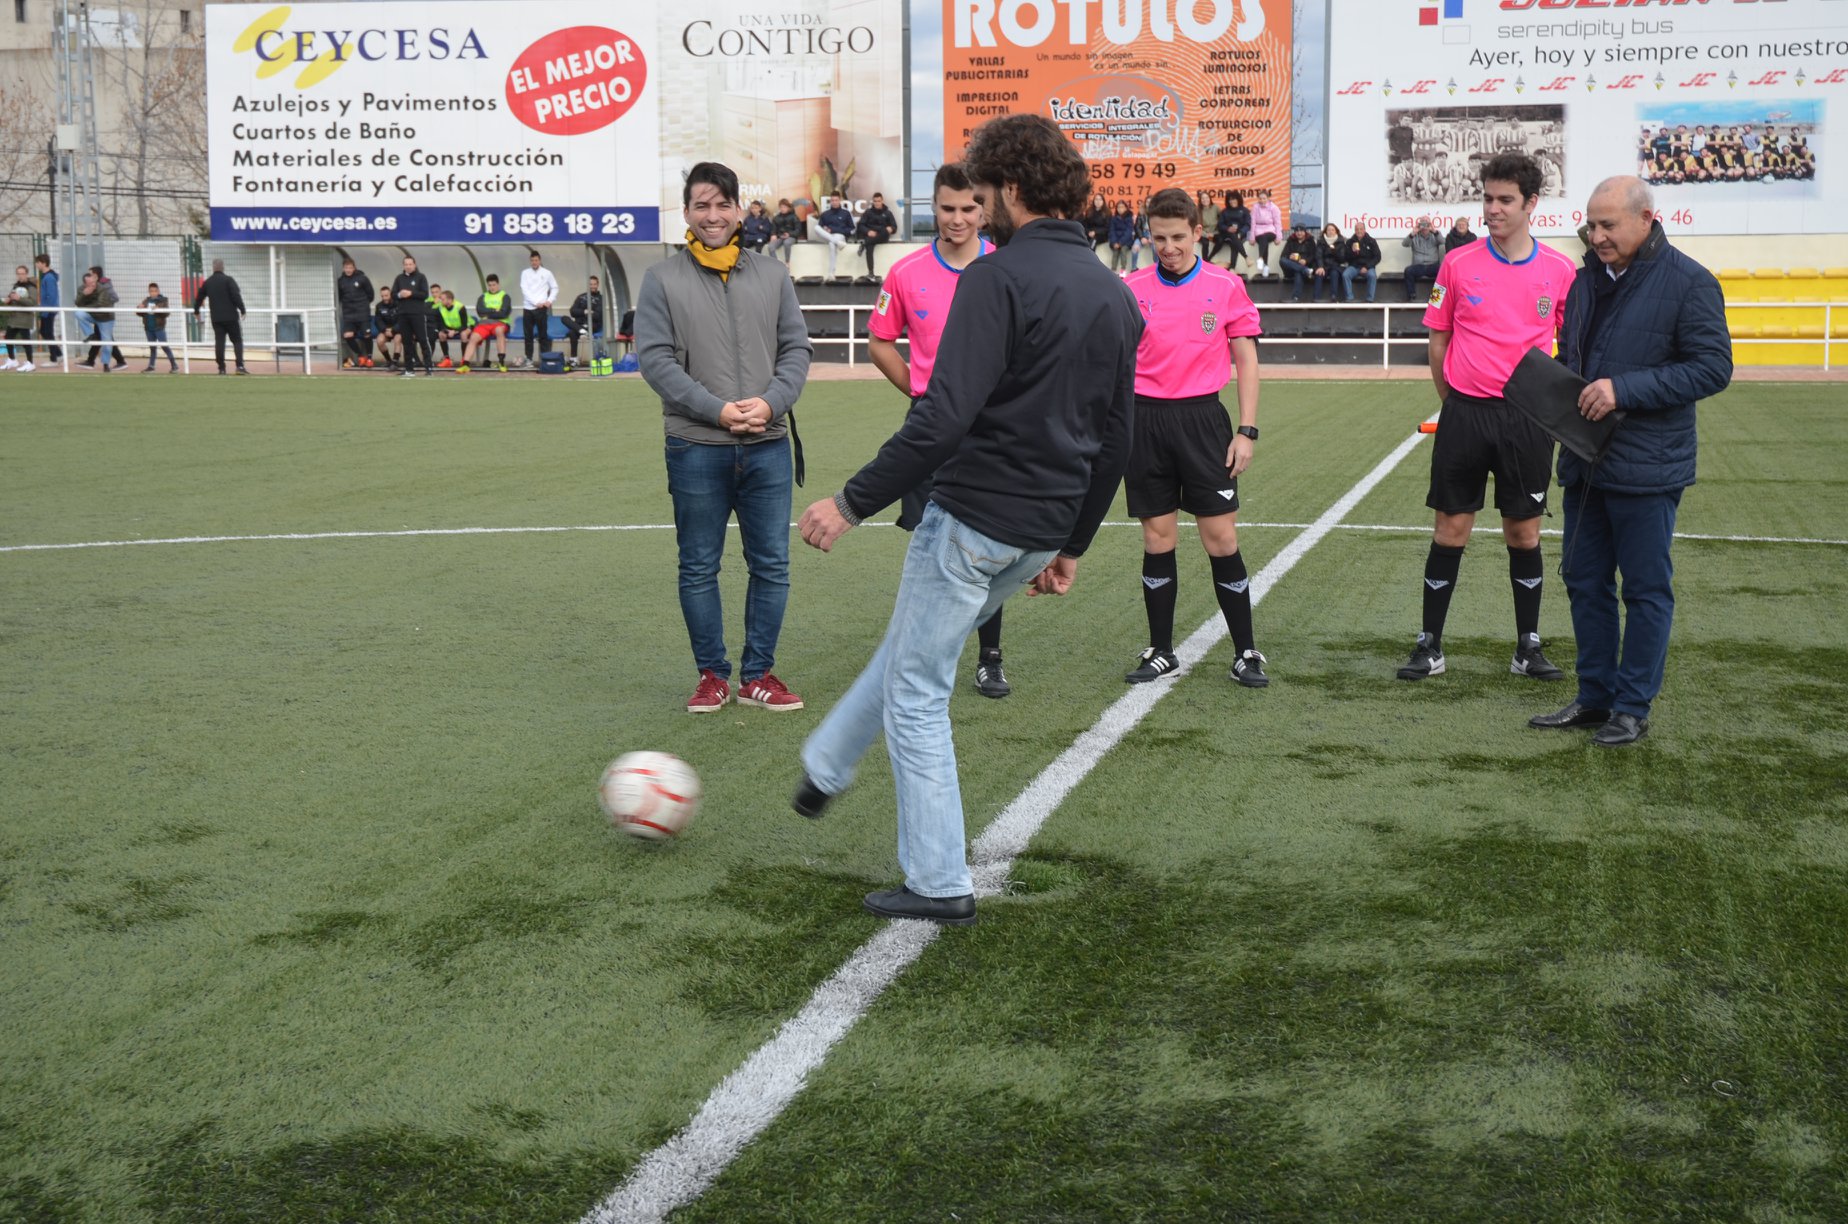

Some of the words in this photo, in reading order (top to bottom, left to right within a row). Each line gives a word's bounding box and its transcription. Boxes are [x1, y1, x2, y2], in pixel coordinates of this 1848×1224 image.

[739, 14, 774, 26] UNA
[781, 13, 823, 25] VIDA
[954, 0, 1266, 48] ROTULOS
[1498, 19, 1624, 40] serendipity
[1632, 19, 1673, 34] bus
[255, 27, 489, 62] CEYCESA
[682, 20, 874, 57] CONTIGO
[969, 56, 1005, 66] VALLAS
[1210, 51, 1260, 60] ROTULOS
[1469, 48, 1523, 69] Ayer,
[1535, 46, 1575, 67] hoy
[1584, 50, 1595, 67] y
[1604, 44, 1698, 65] siempre
[1707, 44, 1748, 58] con
[1758, 39, 1848, 58] nuestro
[510, 67, 539, 94] EL
[545, 39, 634, 85] MEJOR
[946, 69, 1029, 80] PUBLICITARIAS
[1203, 63, 1267, 73] LUMINOSOS
[956, 92, 1018, 102] IMPRESION
[1214, 86, 1251, 95] LETRAS
[233, 94, 329, 117] Azulejos
[339, 100, 350, 116] y
[363, 92, 497, 111] Pavimentos
[534, 76, 631, 124] PRECIO
[1050, 96, 1169, 120] identidad
[1200, 98, 1270, 108] CORPOREAS
[966, 106, 1009, 115] DIGITAL
[233, 123, 316, 140] Cuartos
[325, 121, 351, 139] de
[360, 122, 416, 139] Baño
[1108, 123, 1160, 131] INTEGRALES
[1199, 120, 1271, 129] ROTULACION
[1227, 133, 1242, 142] DE
[233, 149, 362, 166] Materiales
[372, 148, 400, 166] de
[410, 148, 563, 166] Construcción
[1091, 163, 1114, 179] 58
[1122, 164, 1145, 178] 79
[1152, 163, 1175, 177] 49
[1214, 167, 1255, 177] STANDS
[233, 175, 362, 192] Fontanería
[372, 179, 384, 197] y
[395, 174, 533, 192] Calefacción
[230, 216, 397, 233] www.ceycesa.es
[464, 213, 493, 235] 91
[503, 213, 554, 235] 858
[564, 213, 593, 235] 18
[601, 213, 635, 234] 23
[1670, 209, 1693, 224] 46
